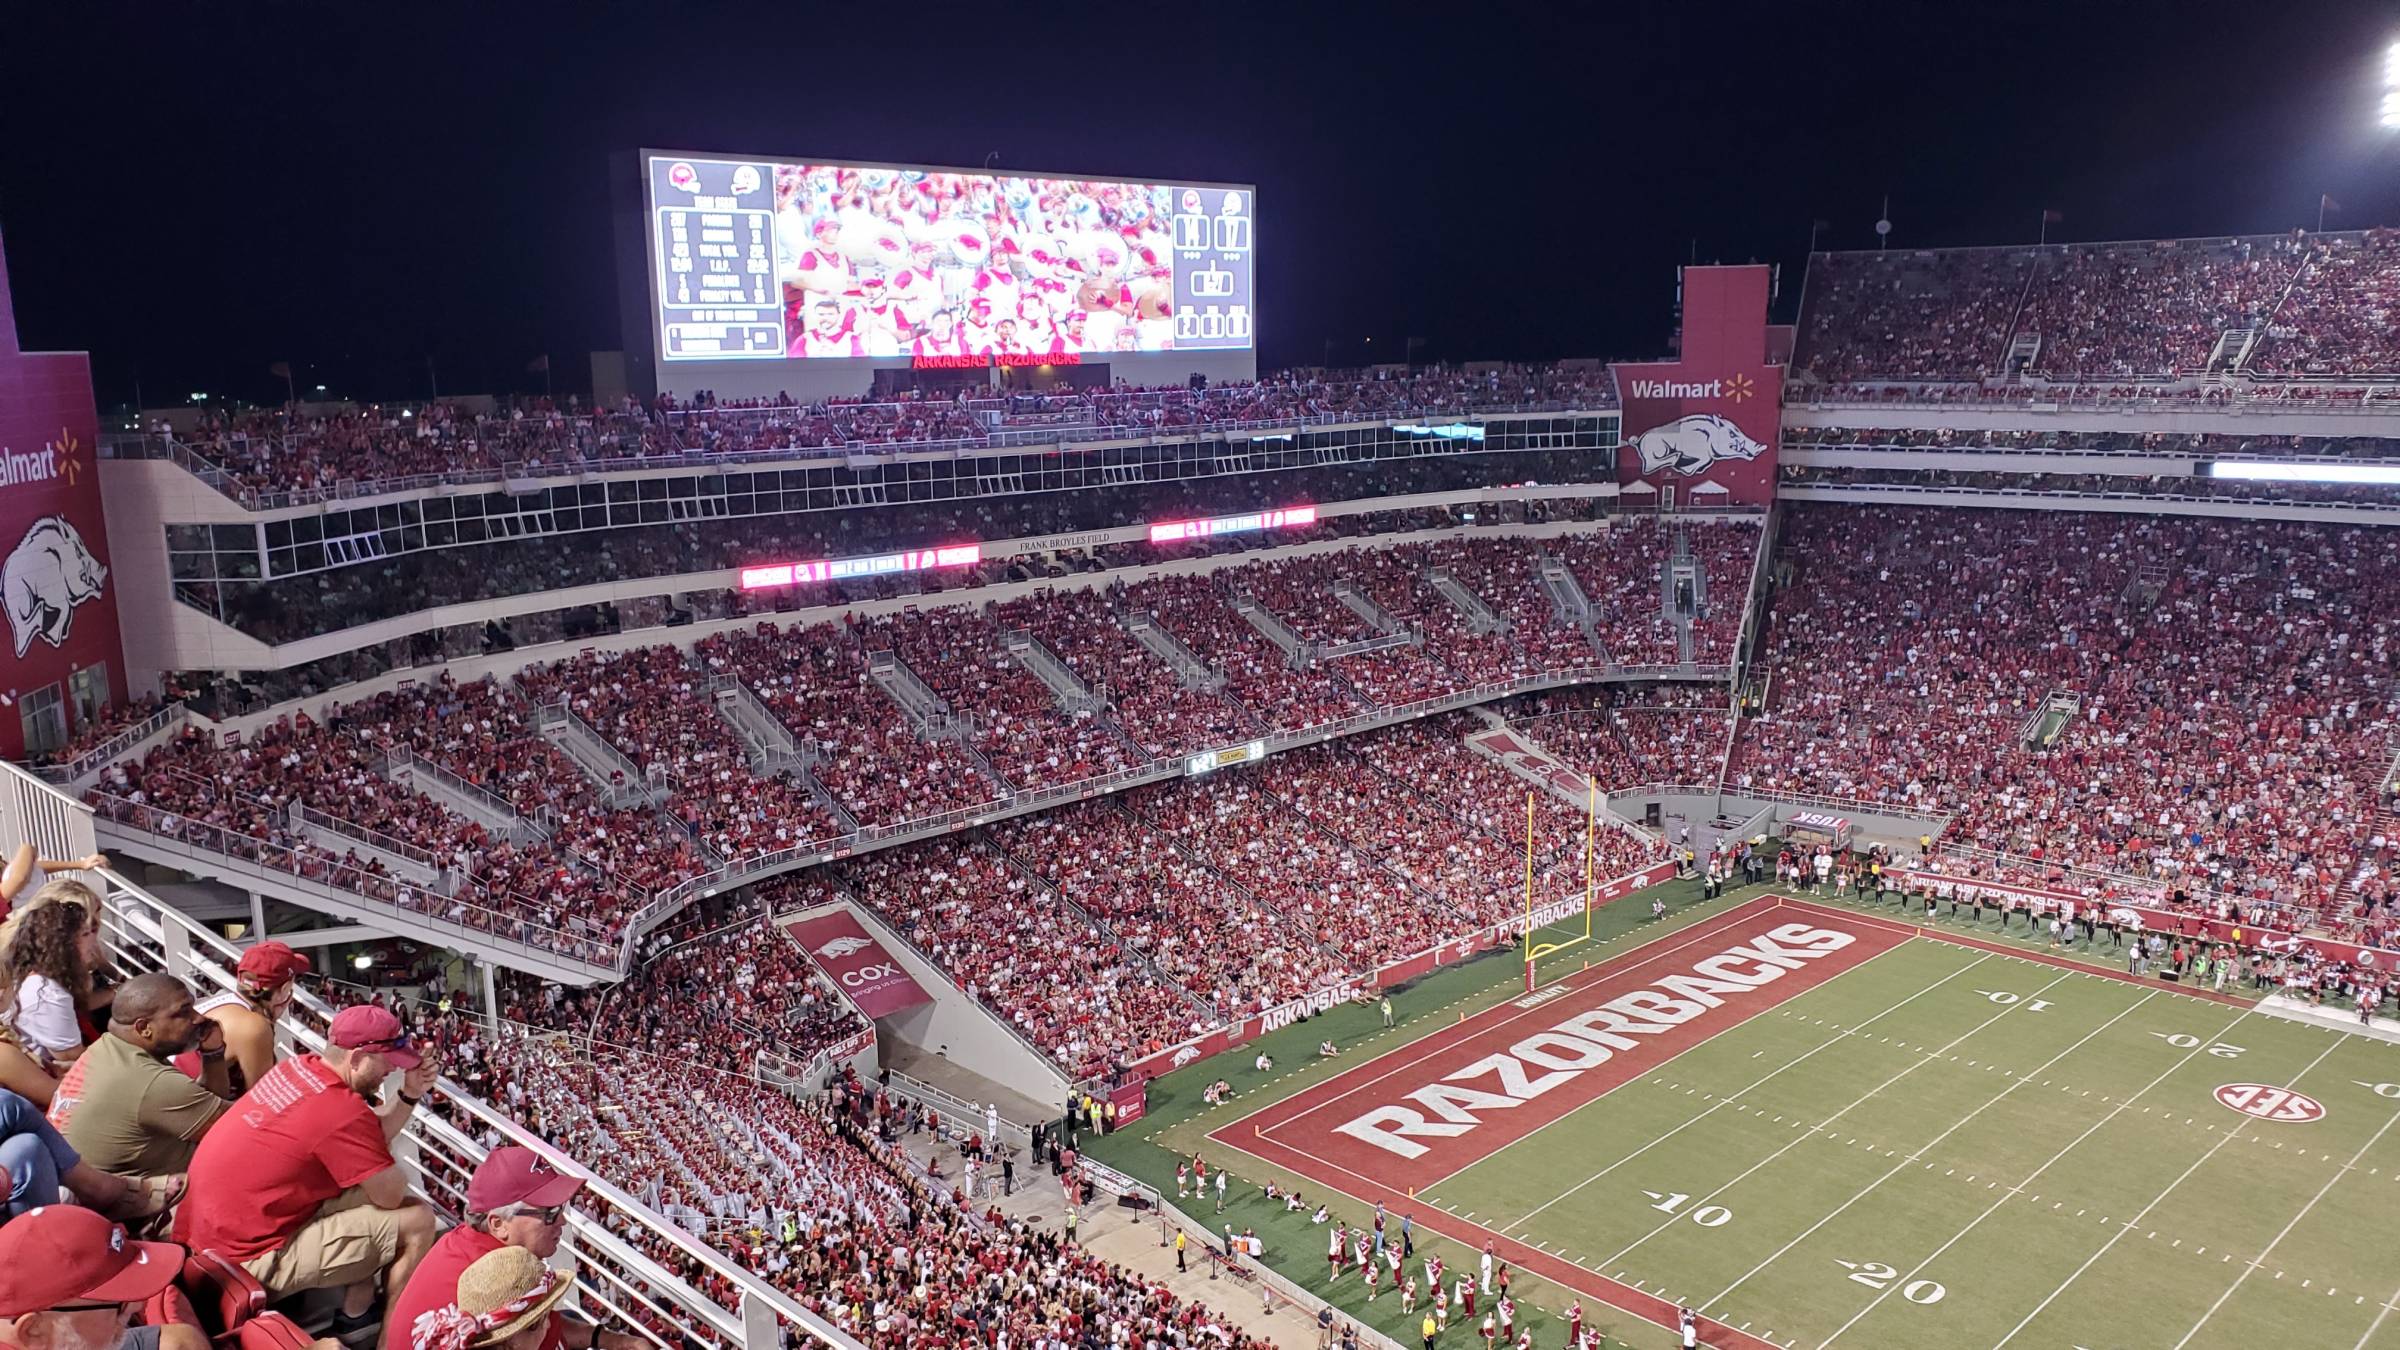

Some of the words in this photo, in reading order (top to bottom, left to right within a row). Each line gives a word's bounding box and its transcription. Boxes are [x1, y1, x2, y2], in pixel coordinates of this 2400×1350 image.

[912, 354, 988, 368] ARKANSAS
[993, 352, 1082, 366] RAZORBACKS
[1631, 379, 1721, 398] Walmart
[0, 442, 57, 487] almart
[1020, 540, 1048, 551] FRANK
[1049, 536, 1086, 548] BROYLES
[1087, 533, 1110, 544] FIELD
[1793, 811, 1843, 827] TUSK
[842, 962, 900, 986] COX
[1260, 984, 1350, 1035] ARKANSAS
[1330, 923, 1856, 1159] RAZORBACKS
[2224, 1085, 2316, 1119] SEC
[1651, 1192, 1732, 1227] 10
[1847, 1262, 1946, 1304] 20
